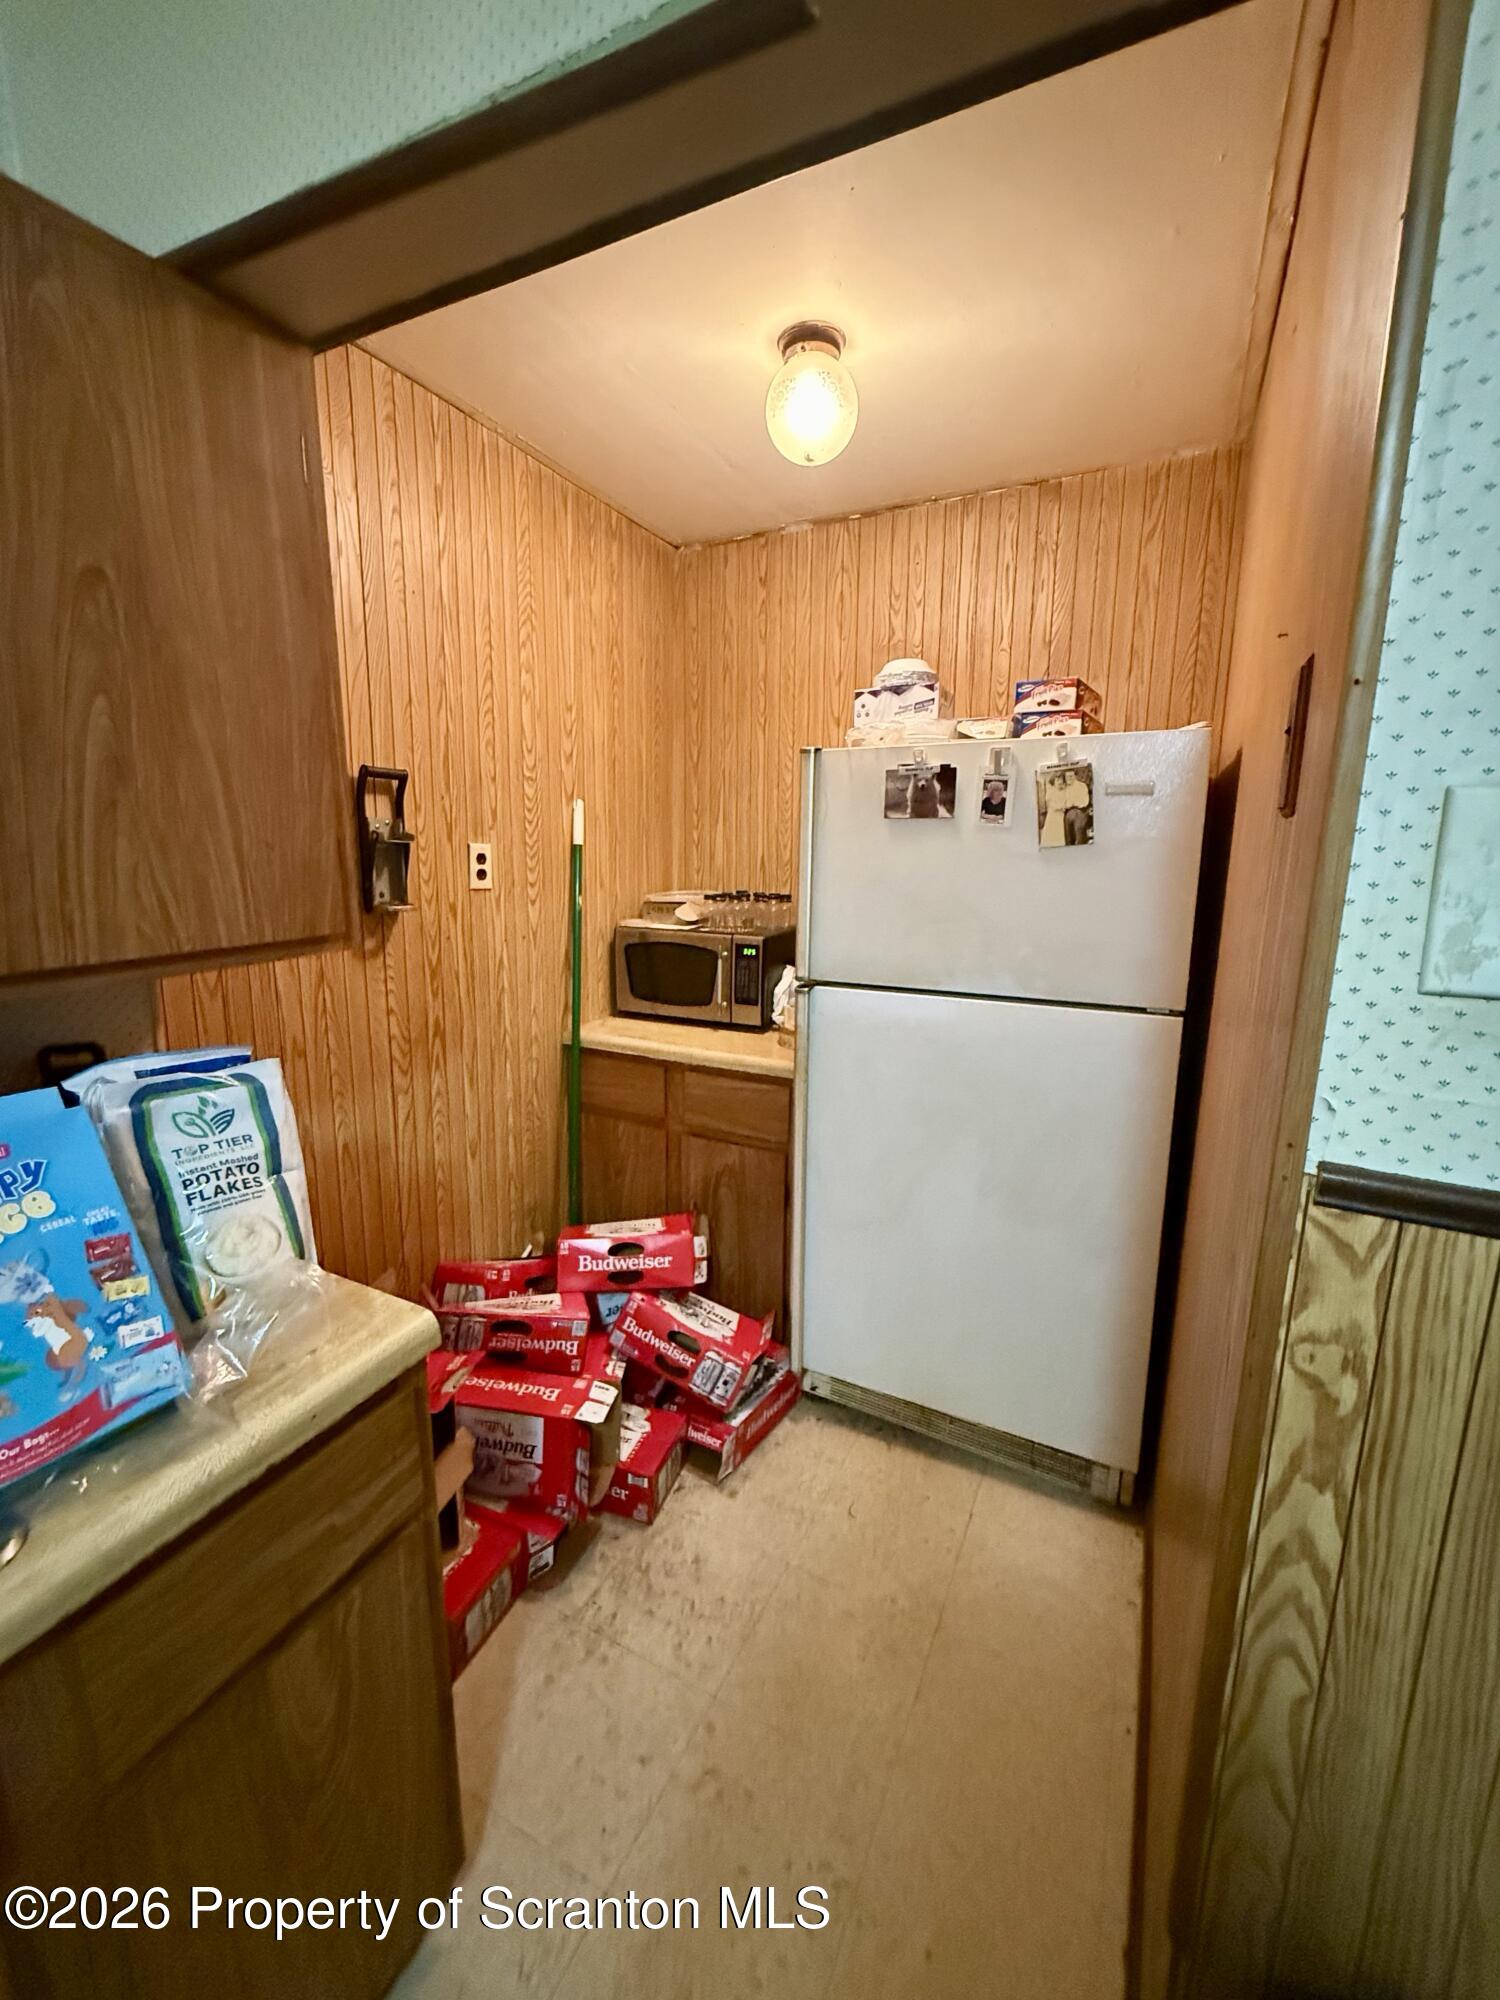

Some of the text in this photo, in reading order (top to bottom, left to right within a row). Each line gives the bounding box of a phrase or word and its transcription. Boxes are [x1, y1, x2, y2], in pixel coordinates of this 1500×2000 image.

[213, 1134, 254, 1149] TIER
[178, 1152, 260, 1179] Instant Mashed
[181, 1161, 260, 1192] POTATO
[184, 1176, 264, 1207] FLAKES
[39, 1215, 77, 1233] CEREAL
[577, 1254, 673, 1272] Budweiser
[488, 1337, 580, 1356] Budweiser
[621, 1315, 697, 1368] Budweiser
[463, 1376, 562, 1403] Budweise
